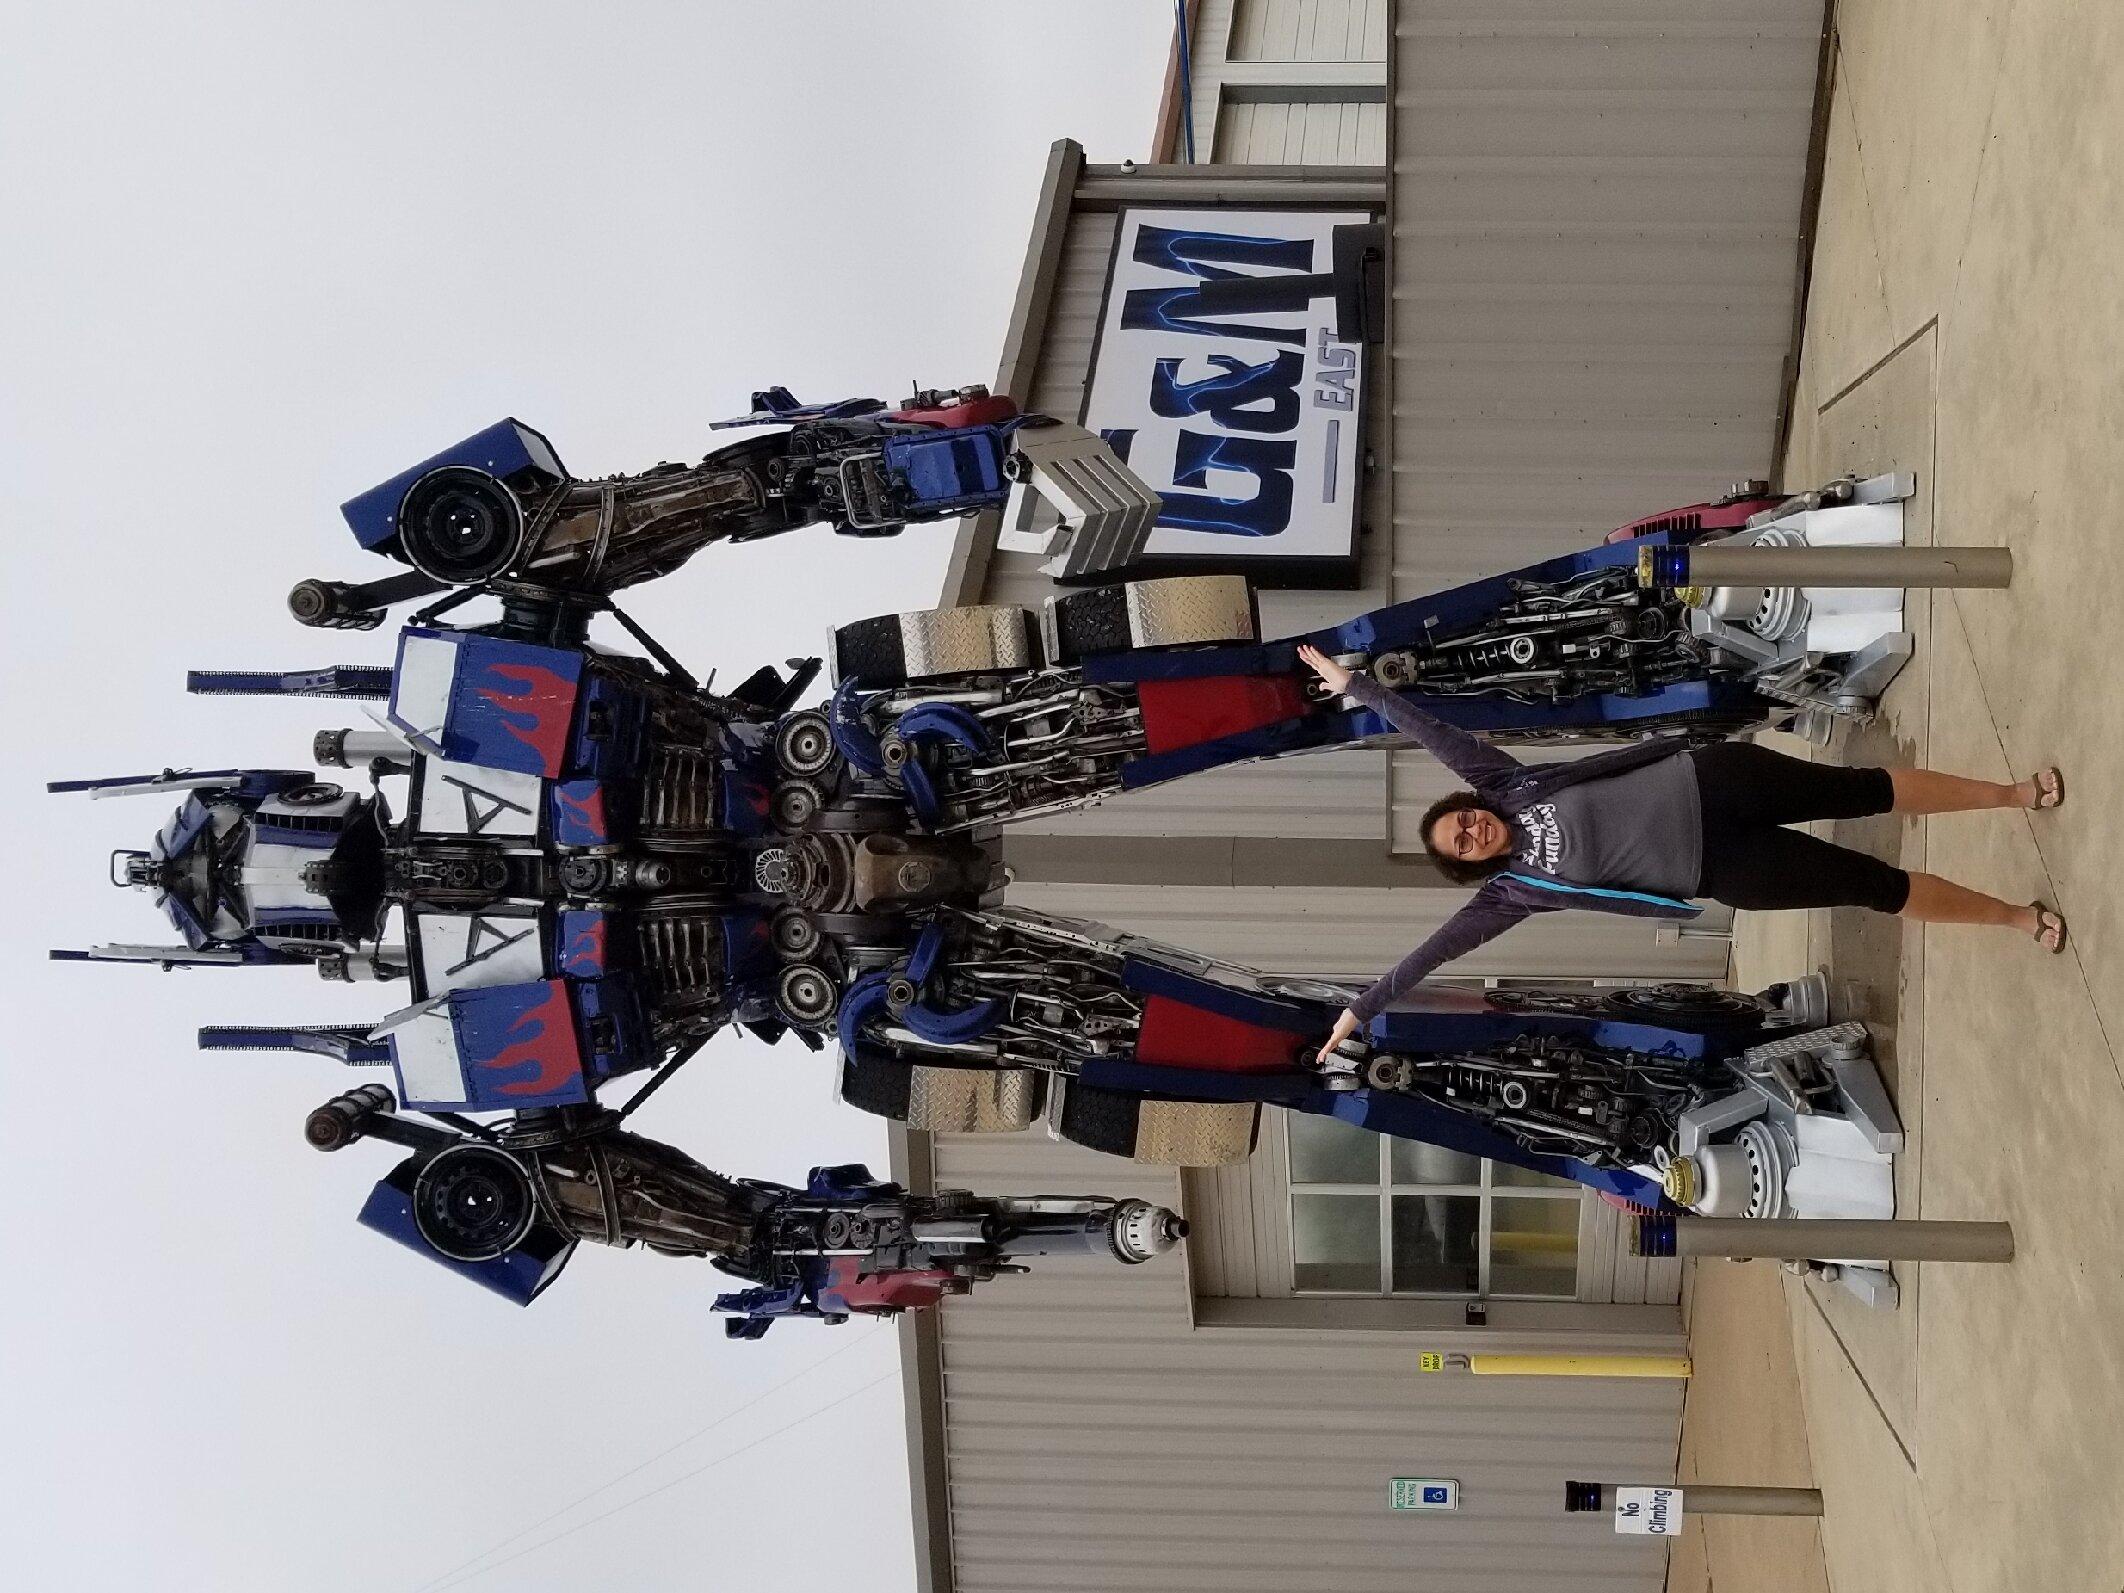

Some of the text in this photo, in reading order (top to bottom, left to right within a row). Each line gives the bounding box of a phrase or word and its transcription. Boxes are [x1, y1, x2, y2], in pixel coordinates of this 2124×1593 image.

[1100, 223, 1314, 538] G&M
[1313, 328, 1356, 412] EAST
[1536, 803, 1560, 875] Funday
[1432, 1355, 1440, 1369] DROP
[1408, 1484, 1416, 1505] PARKING
[1622, 1502, 1639, 1517] No
[1648, 1490, 1672, 1534] Climbing
